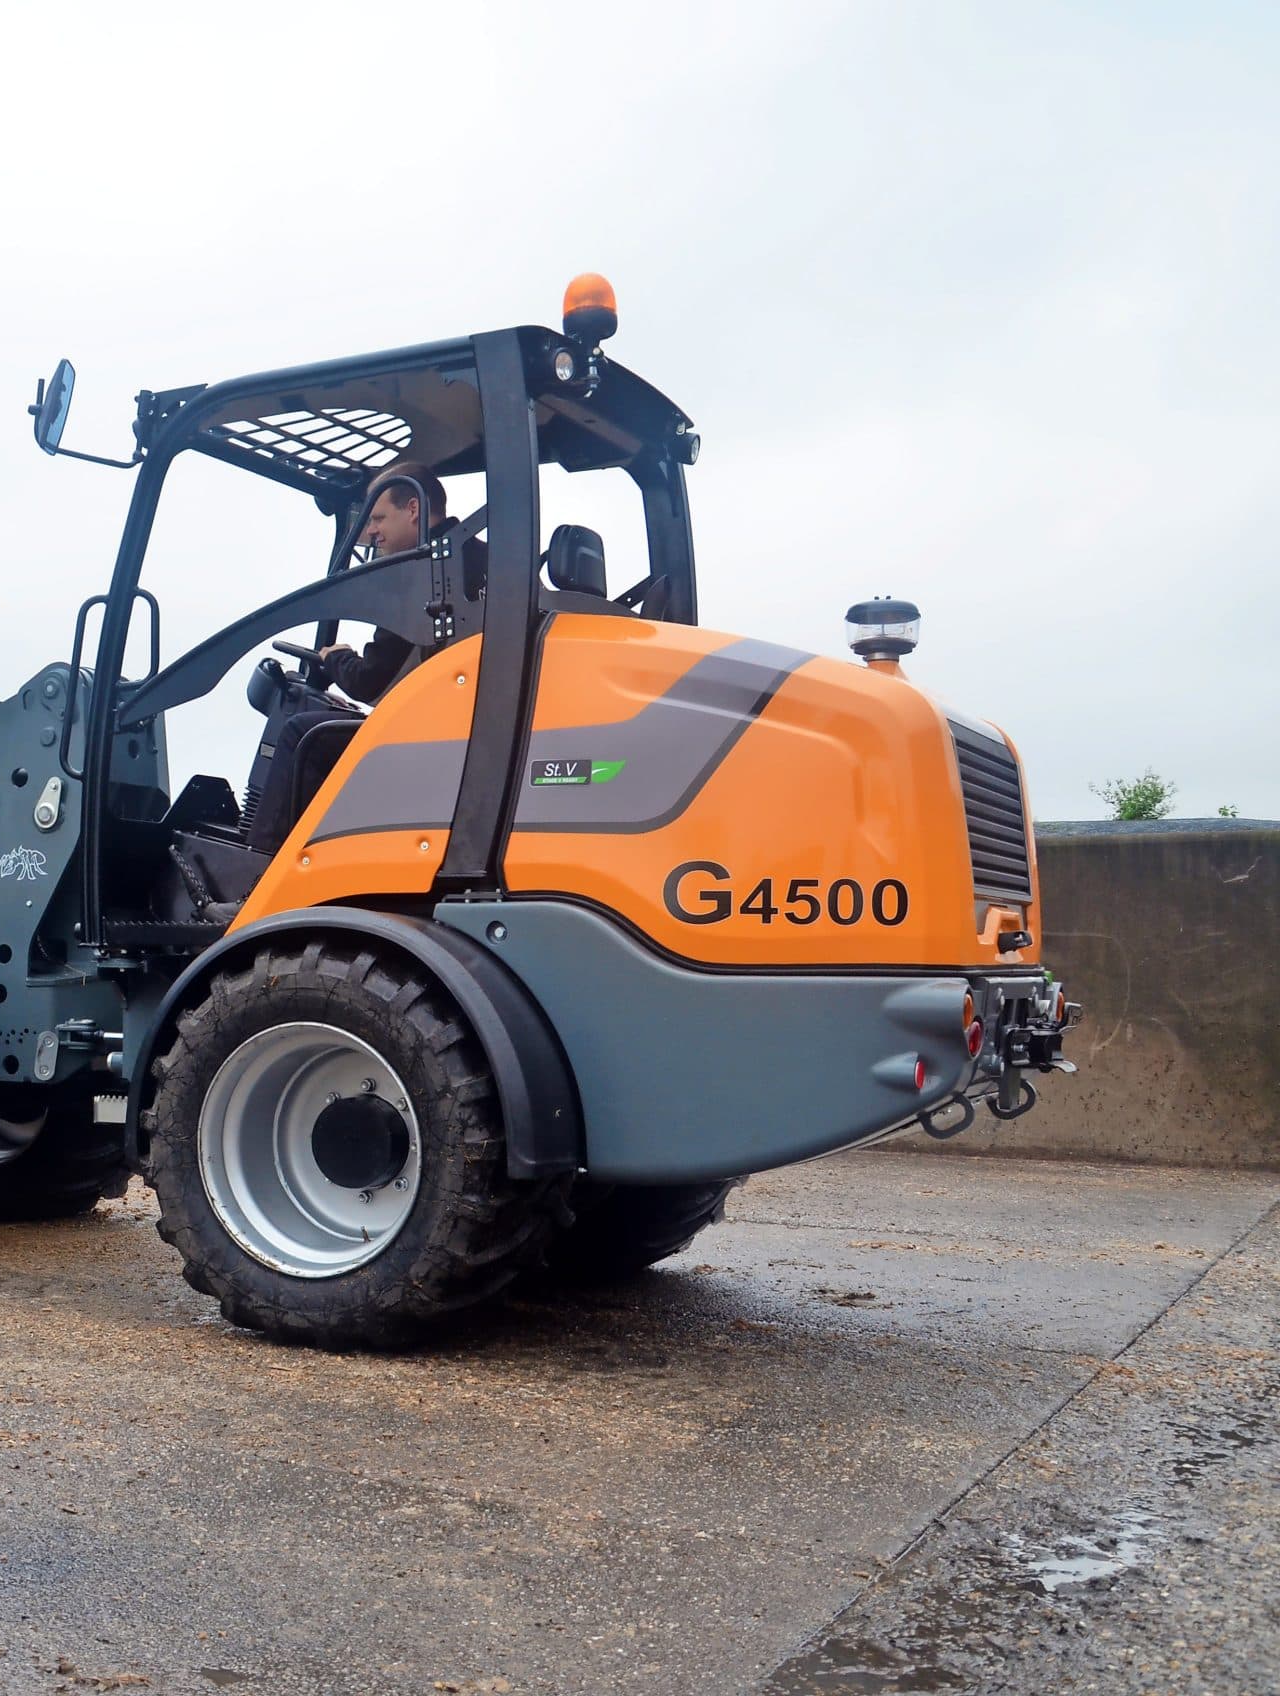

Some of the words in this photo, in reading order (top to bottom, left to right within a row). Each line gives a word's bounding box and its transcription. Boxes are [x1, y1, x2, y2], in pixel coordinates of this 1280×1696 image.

[544, 763, 562, 777] St.
[566, 762, 577, 776] V
[663, 860, 909, 925] G4500
